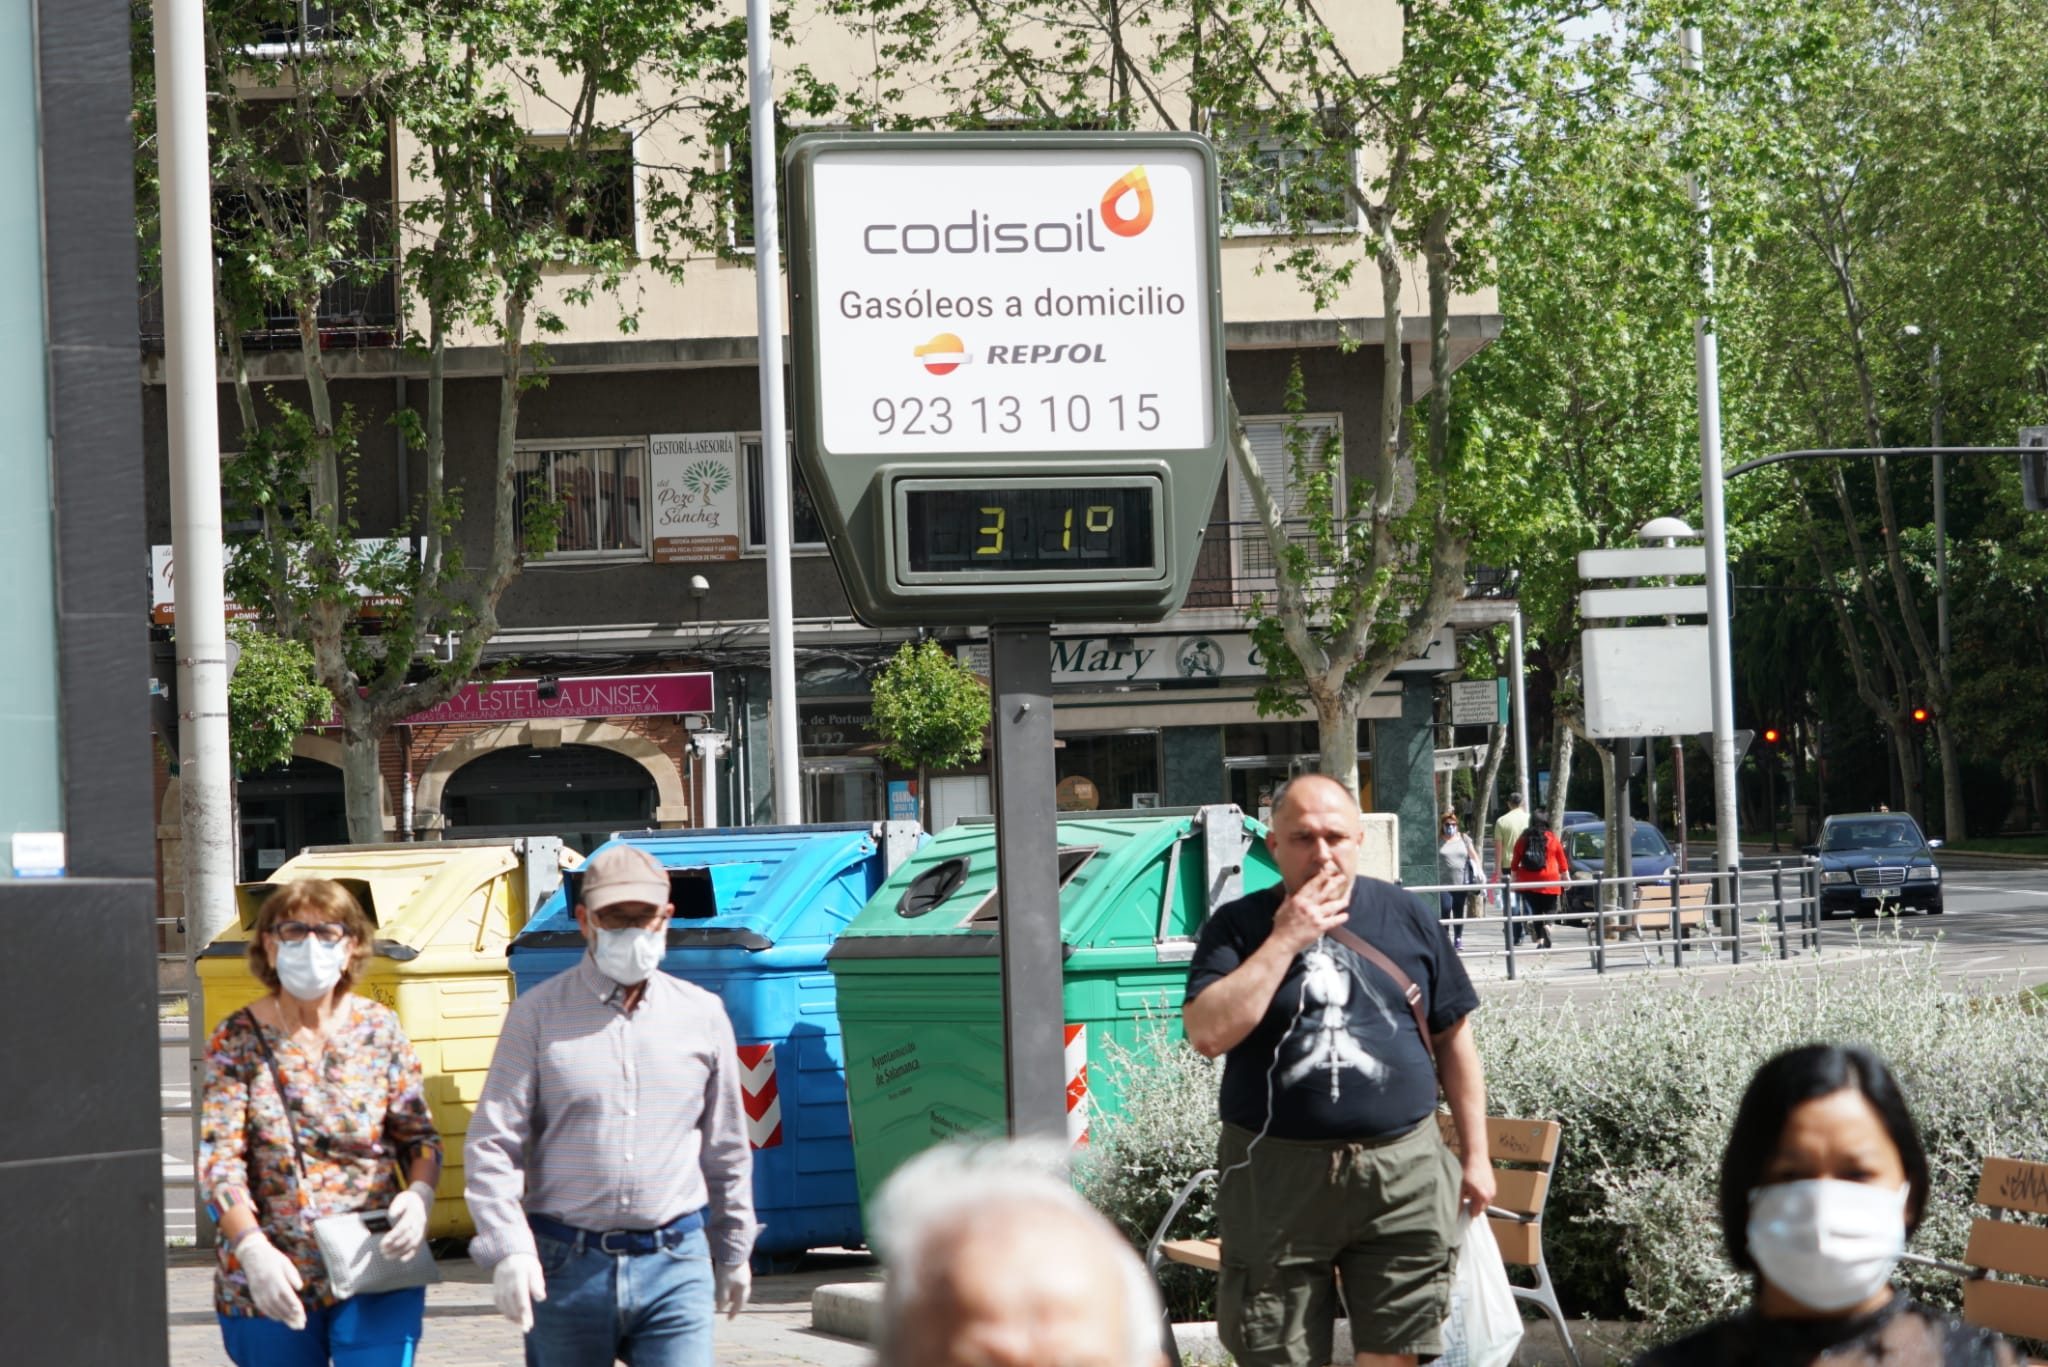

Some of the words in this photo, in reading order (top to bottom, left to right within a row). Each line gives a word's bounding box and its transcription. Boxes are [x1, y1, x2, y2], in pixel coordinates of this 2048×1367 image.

[864, 209, 1105, 254] codisoil
[840, 290, 994, 319] Gasóleos
[1005, 294, 1023, 317] a
[1035, 286, 1185, 317] domicilio
[987, 343, 1107, 365] REPSOL
[872, 396, 953, 436] 923
[971, 396, 1022, 434] 13
[1040, 395, 1091, 432] 10
[1109, 393, 1161, 432] 15
[652, 436, 734, 455] GESTORÍA-ASESORÍA
[658, 488, 695, 509] Pozo
[660, 507, 720, 528] Sánchez
[1050, 640, 1156, 680] Mary
[458, 694, 471, 712] Y
[580, 684, 659, 707] UNISEX
[811, 715, 825, 725] de
[884, 1058, 919, 1083] Salamanca
